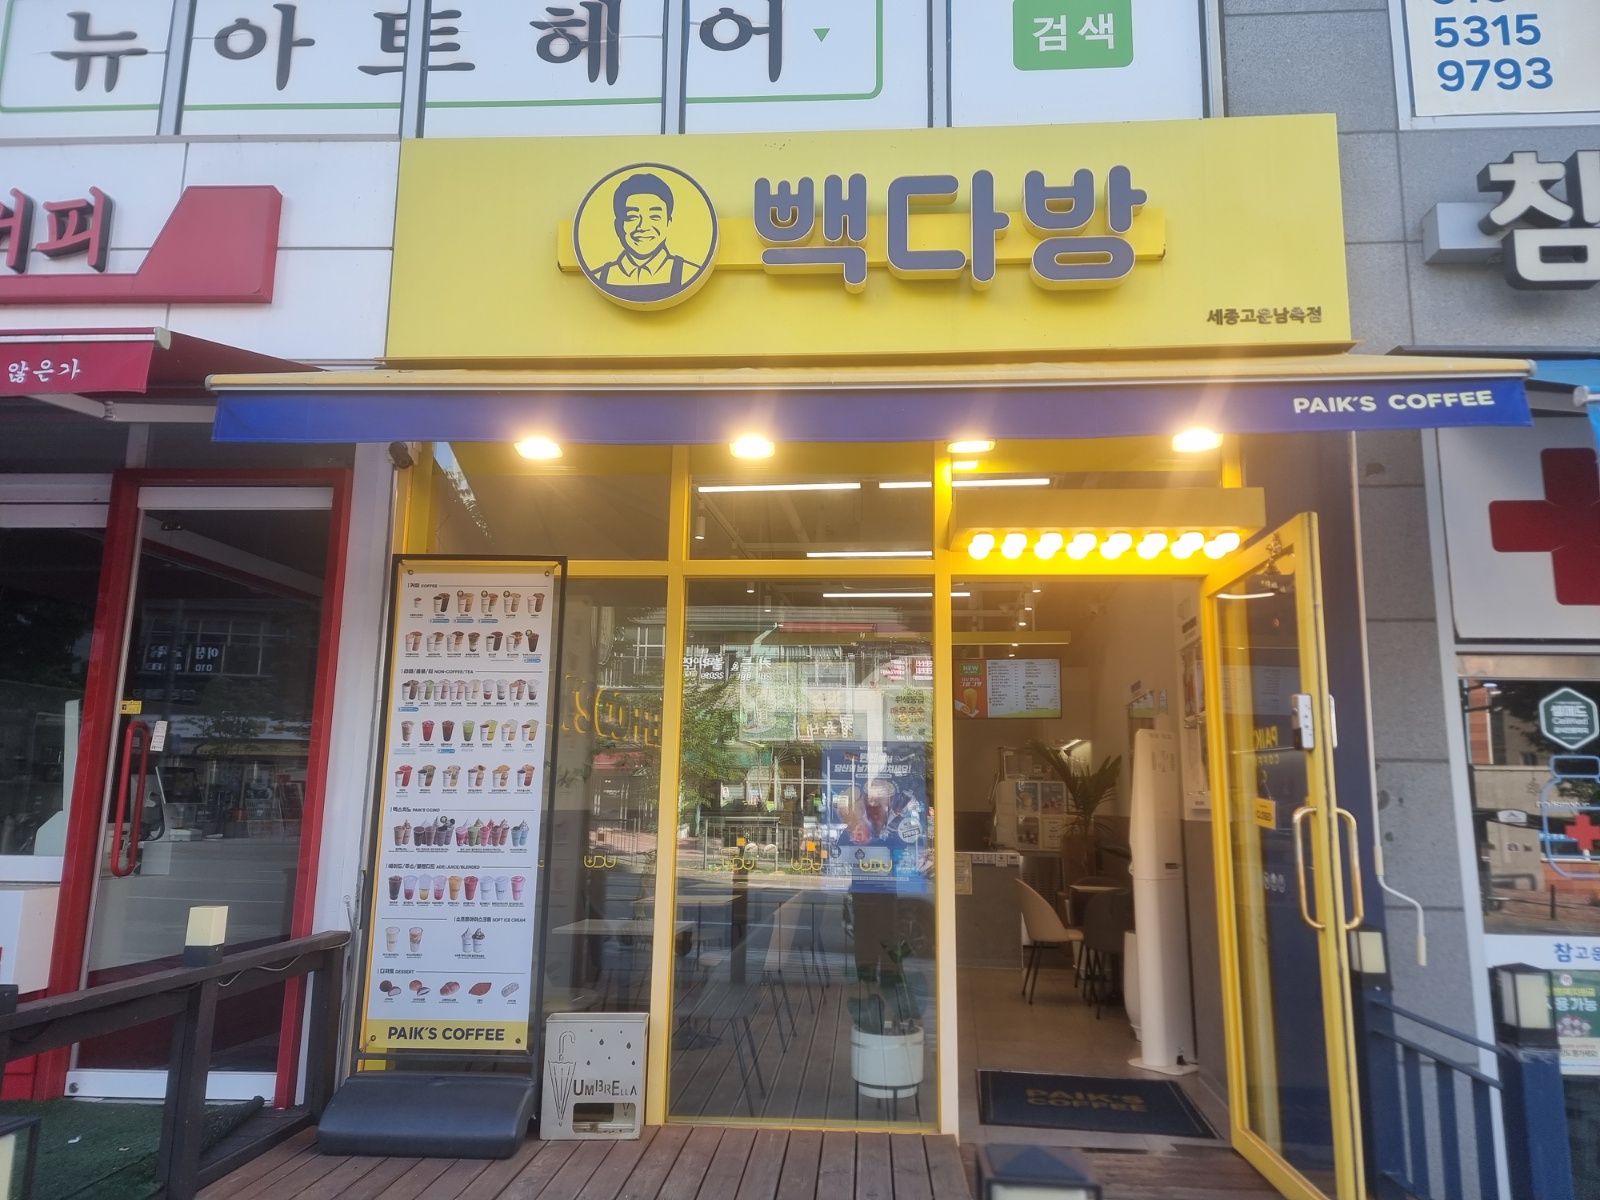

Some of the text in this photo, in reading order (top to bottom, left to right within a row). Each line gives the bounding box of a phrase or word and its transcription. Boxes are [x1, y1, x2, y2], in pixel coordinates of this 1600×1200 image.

[1032, 14, 1117, 52] 검색
[1434, 13, 1541, 48] 5315
[1437, 57, 1554, 92] 9793
[753, 163, 1149, 297] 빽다방
[1206, 306, 1323, 326] 세종고운남측점
[7, 357, 81, 384] 않은가
[1293, 389, 1495, 416] PAIK'S COFFEE
[1546, 996, 1598, 1012] 용가능
[387, 1026, 506, 1042] PAIK'S COFFEE
[573, 1080, 638, 1097] UMBRELLA
[1026, 1098, 1149, 1113] COFFEE
